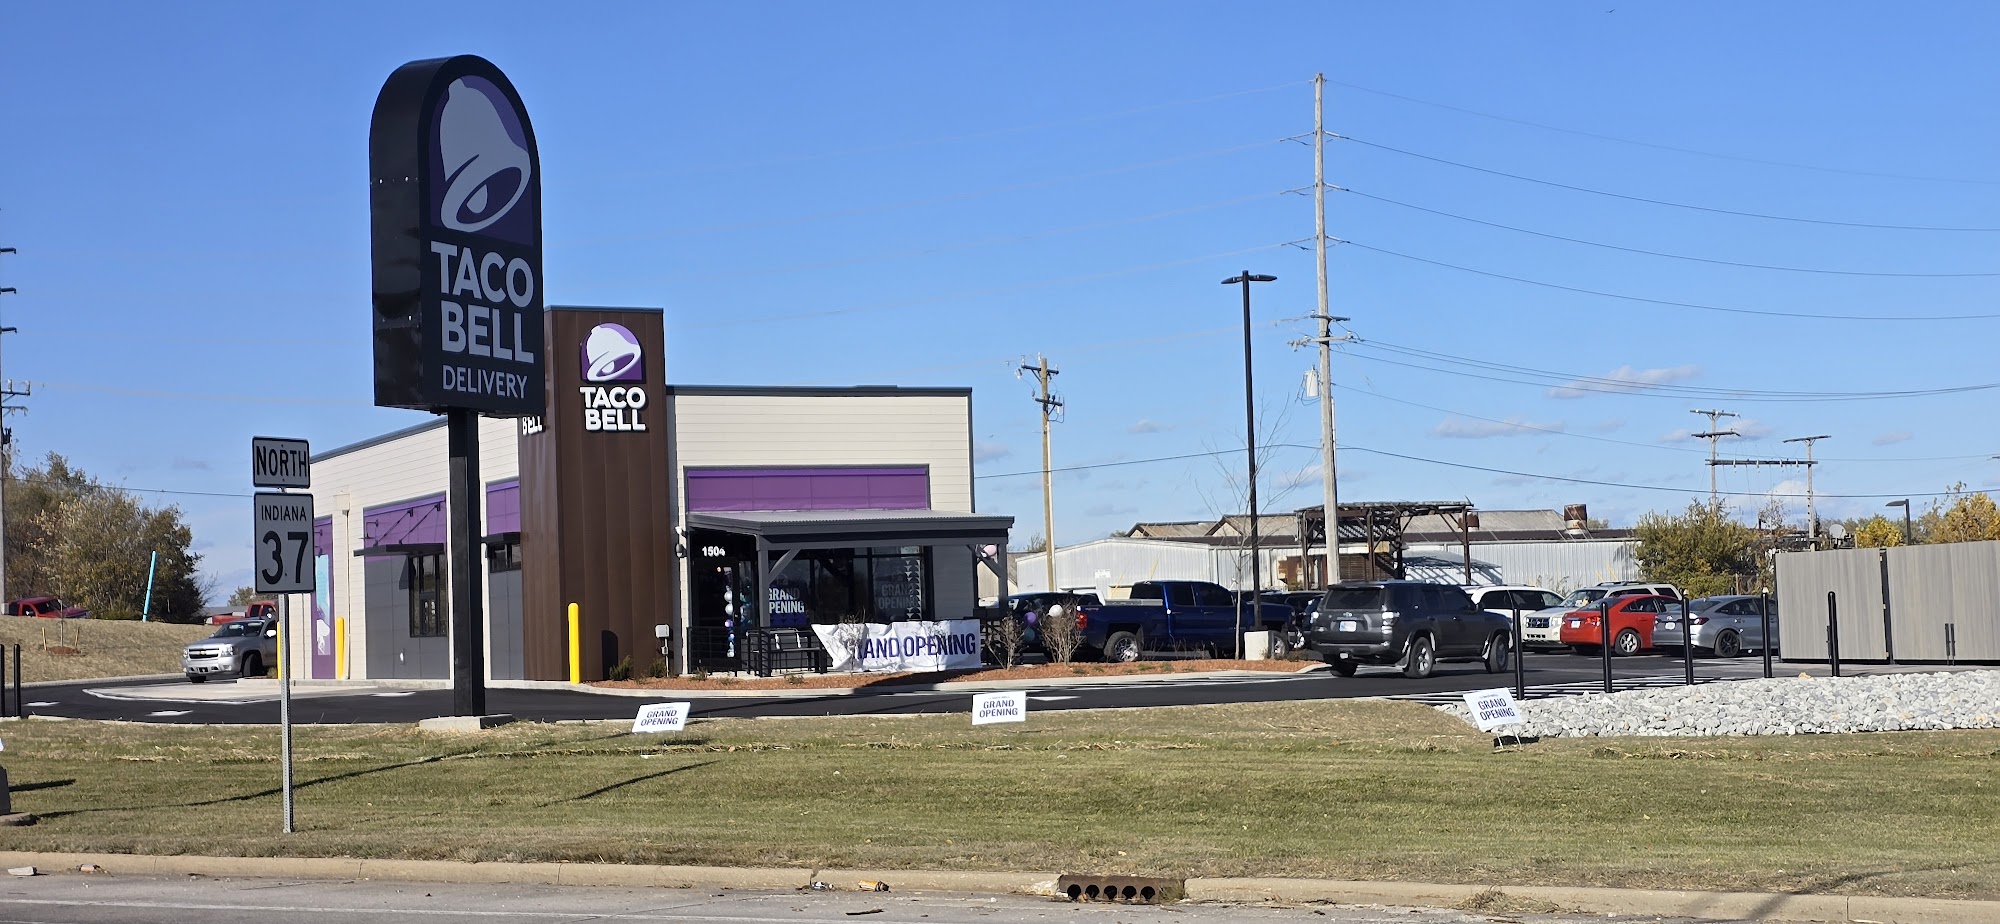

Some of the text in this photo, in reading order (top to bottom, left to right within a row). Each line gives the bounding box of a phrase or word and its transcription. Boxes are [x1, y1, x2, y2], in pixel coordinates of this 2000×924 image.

[431, 240, 534, 308] TACO
[441, 300, 534, 363] BELL
[442, 364, 528, 399] DELIVERY
[579, 386, 646, 409] TACO
[522, 415, 543, 436] BELL
[585, 409, 646, 431] BELL
[256, 445, 307, 477] NORTH
[261, 504, 307, 522] INDIANA
[261, 530, 309, 585] 37
[702, 546, 726, 557] 1504
[768, 601, 805, 614] PENING
[903, 632, 976, 658] OPENING
[646, 709, 678, 718] GRAND
[979, 707, 1018, 718] OPENING
[983, 699, 1015, 709] GRAND
[1478, 698, 1506, 710] GRAND
[640, 717, 679, 727] OPENING
[1480, 708, 1515, 720] OPENING
